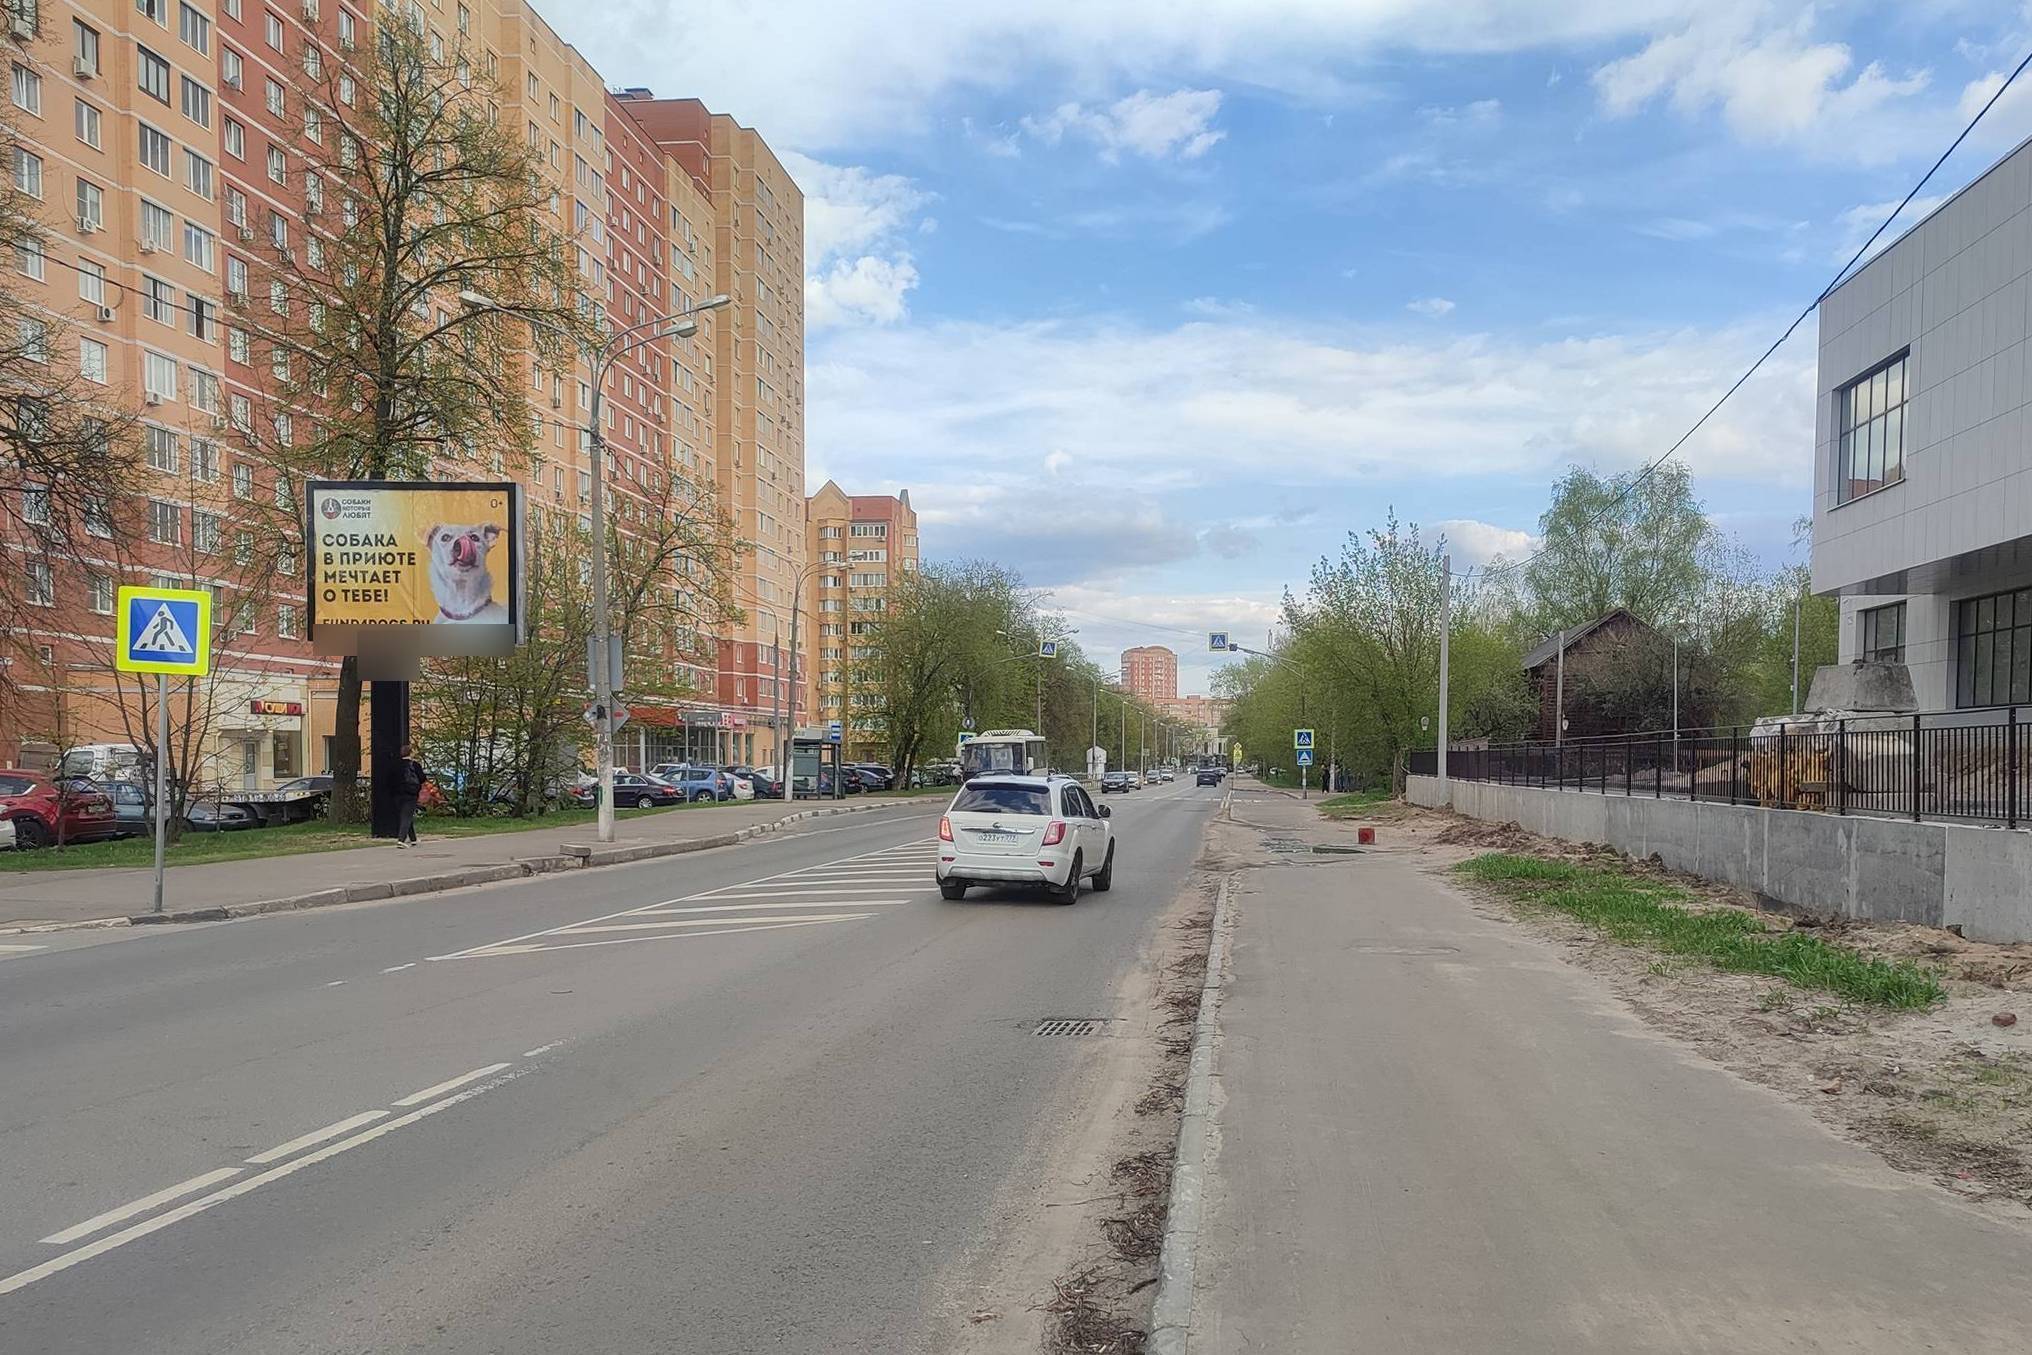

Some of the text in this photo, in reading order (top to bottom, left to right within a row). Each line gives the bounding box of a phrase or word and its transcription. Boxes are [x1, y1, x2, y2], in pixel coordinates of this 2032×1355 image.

[322, 533, 398, 547] СОБАКА
[323, 551, 416, 566] В ПРИЮТЕ
[324, 570, 401, 583] МЕЧТАЕТ
[322, 588, 388, 602] О ТЕБЕ!
